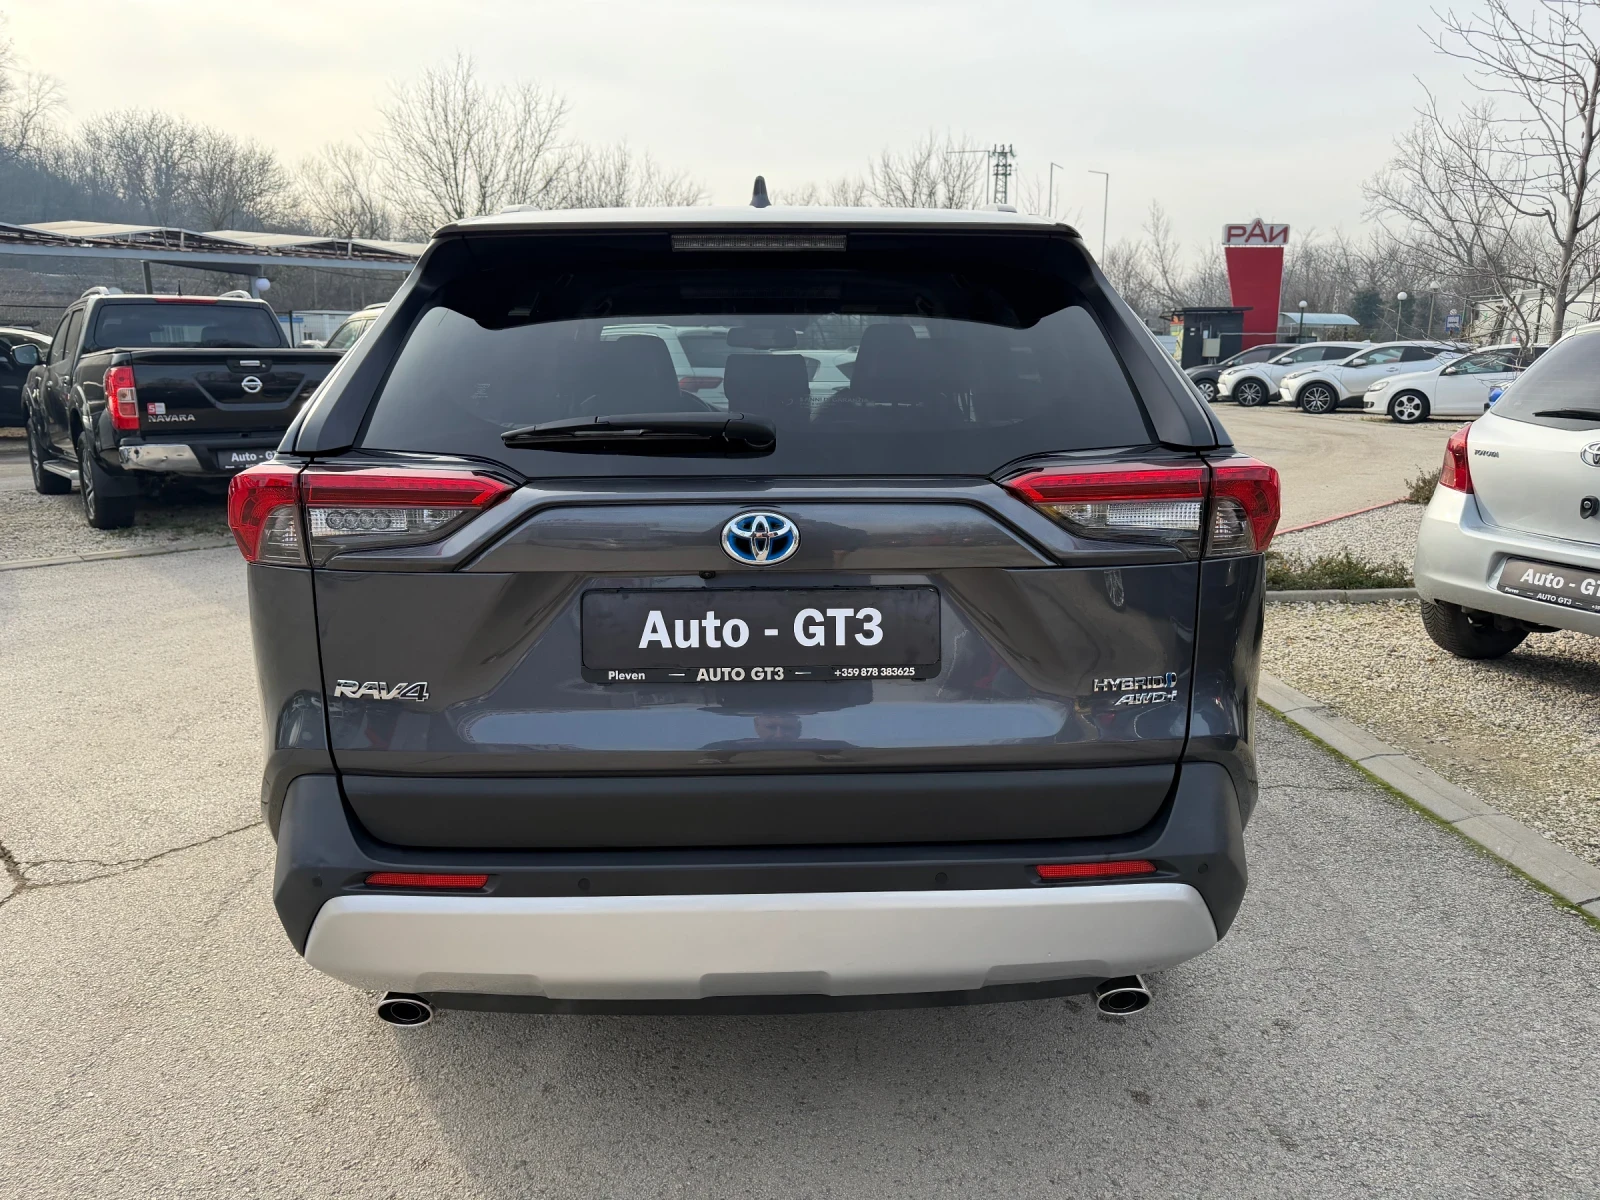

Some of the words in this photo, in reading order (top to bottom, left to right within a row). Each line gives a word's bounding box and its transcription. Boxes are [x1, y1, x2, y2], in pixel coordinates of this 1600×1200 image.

[148, 414, 196, 423] NAVARA
[231, 452, 258, 462] Auto
[1520, 568, 1565, 589] Auto
[1536, 592, 1557, 602] AUTO
[1557, 596, 1572, 605] GT3
[638, 609, 750, 649] Auto
[793, 607, 884, 647] GT3
[608, 670, 646, 681] Pleven
[696, 667, 746, 682] AUTO
[750, 666, 785, 681] GT3
[834, 668, 859, 677] +359
[860, 668, 878, 677] 878
[880, 667, 916, 677] 383625
[333, 679, 430, 702] RAV4
[1093, 675, 1165, 692] HYBRID
